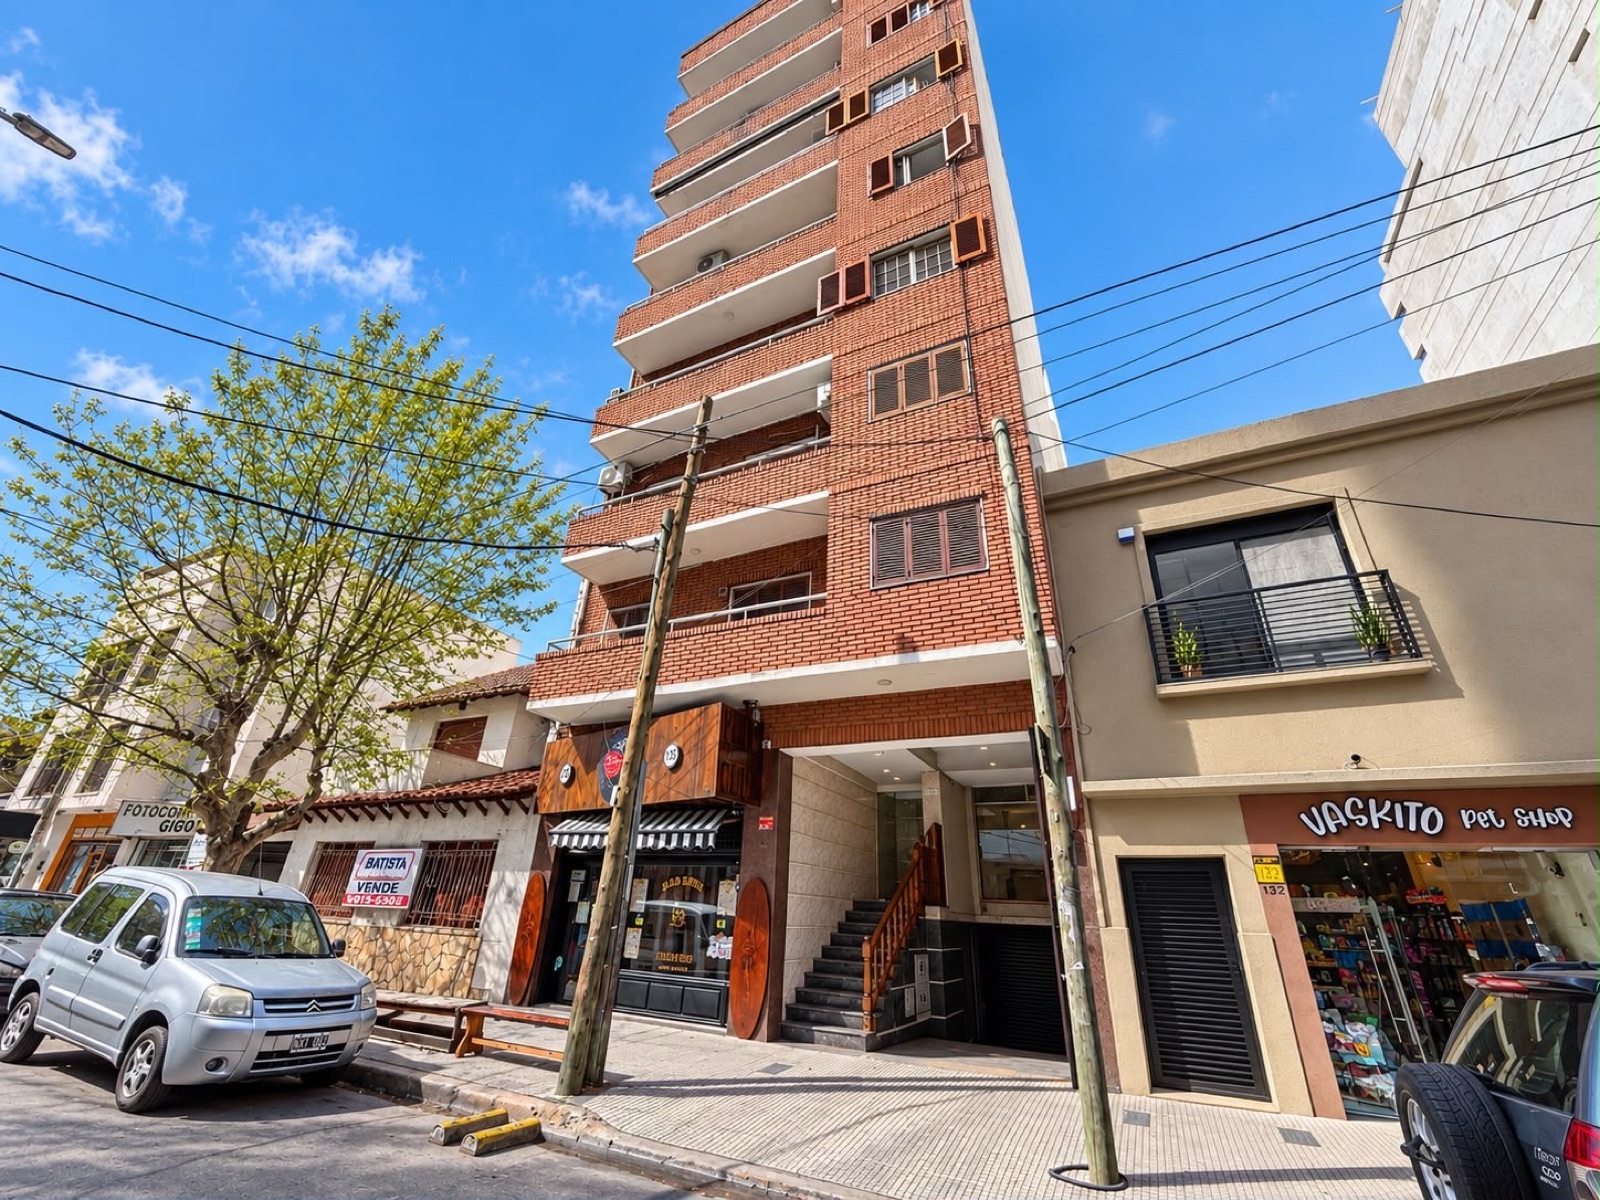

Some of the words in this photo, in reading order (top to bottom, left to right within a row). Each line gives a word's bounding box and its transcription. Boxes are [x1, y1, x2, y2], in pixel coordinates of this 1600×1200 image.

[123, 804, 190, 819] FOTOCO
[1300, 797, 1445, 836] VASKITO
[365, 857, 407, 870] BATISTA
[357, 882, 399, 893] VENDE
[1263, 885, 1285, 895] 132
